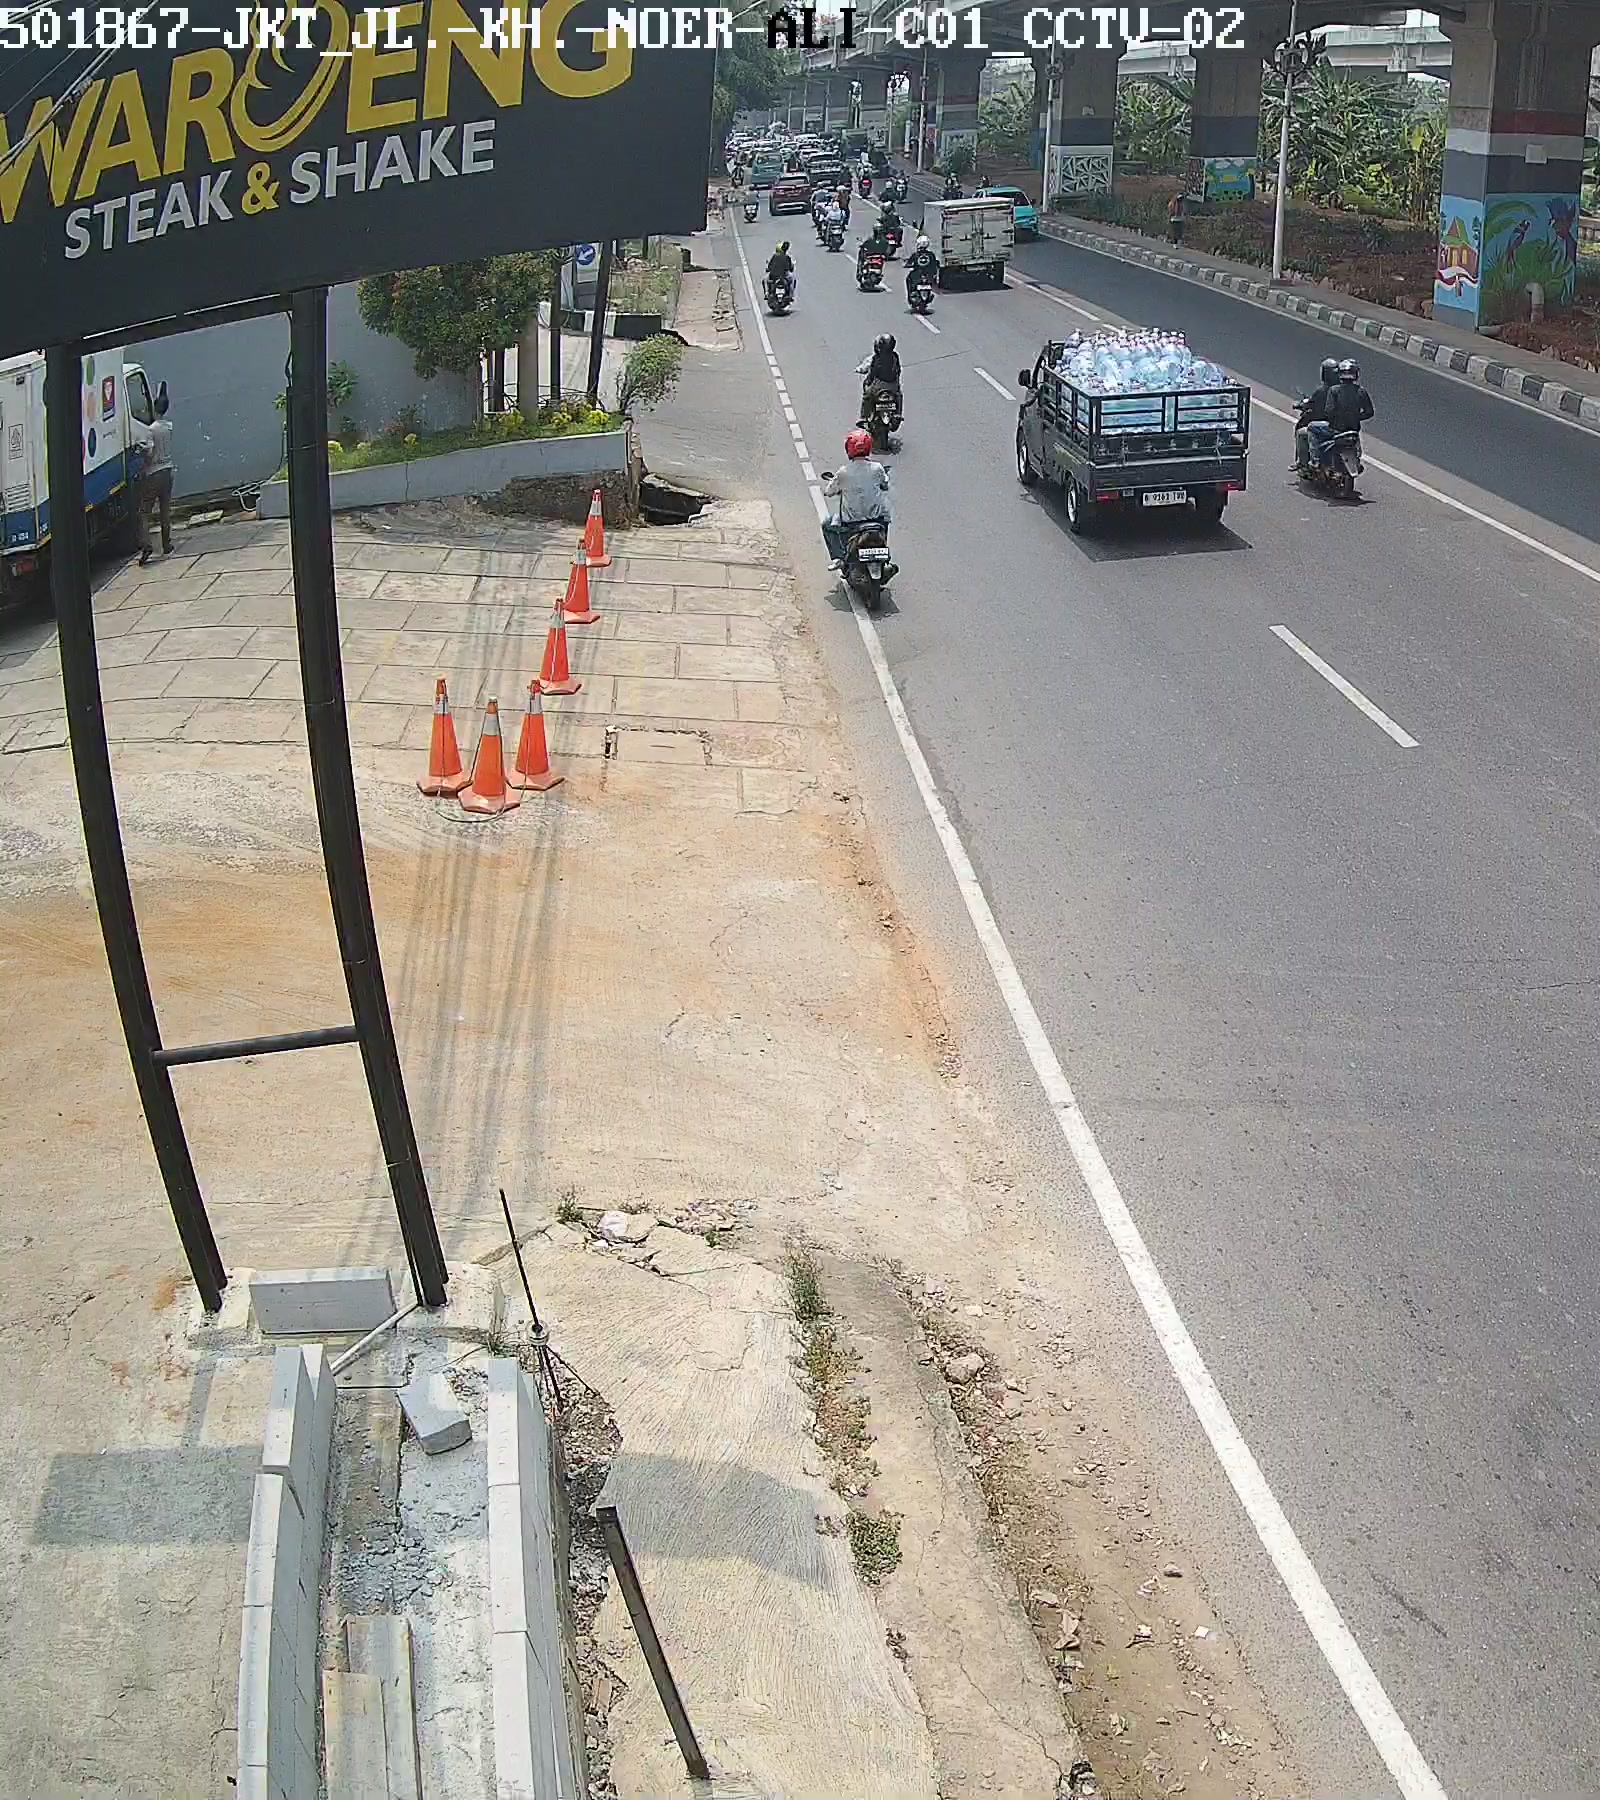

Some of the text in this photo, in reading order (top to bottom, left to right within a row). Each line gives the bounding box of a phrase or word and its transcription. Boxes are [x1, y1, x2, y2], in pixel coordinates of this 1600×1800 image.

[63, 119, 497, 260] STEAK & SHAKE
